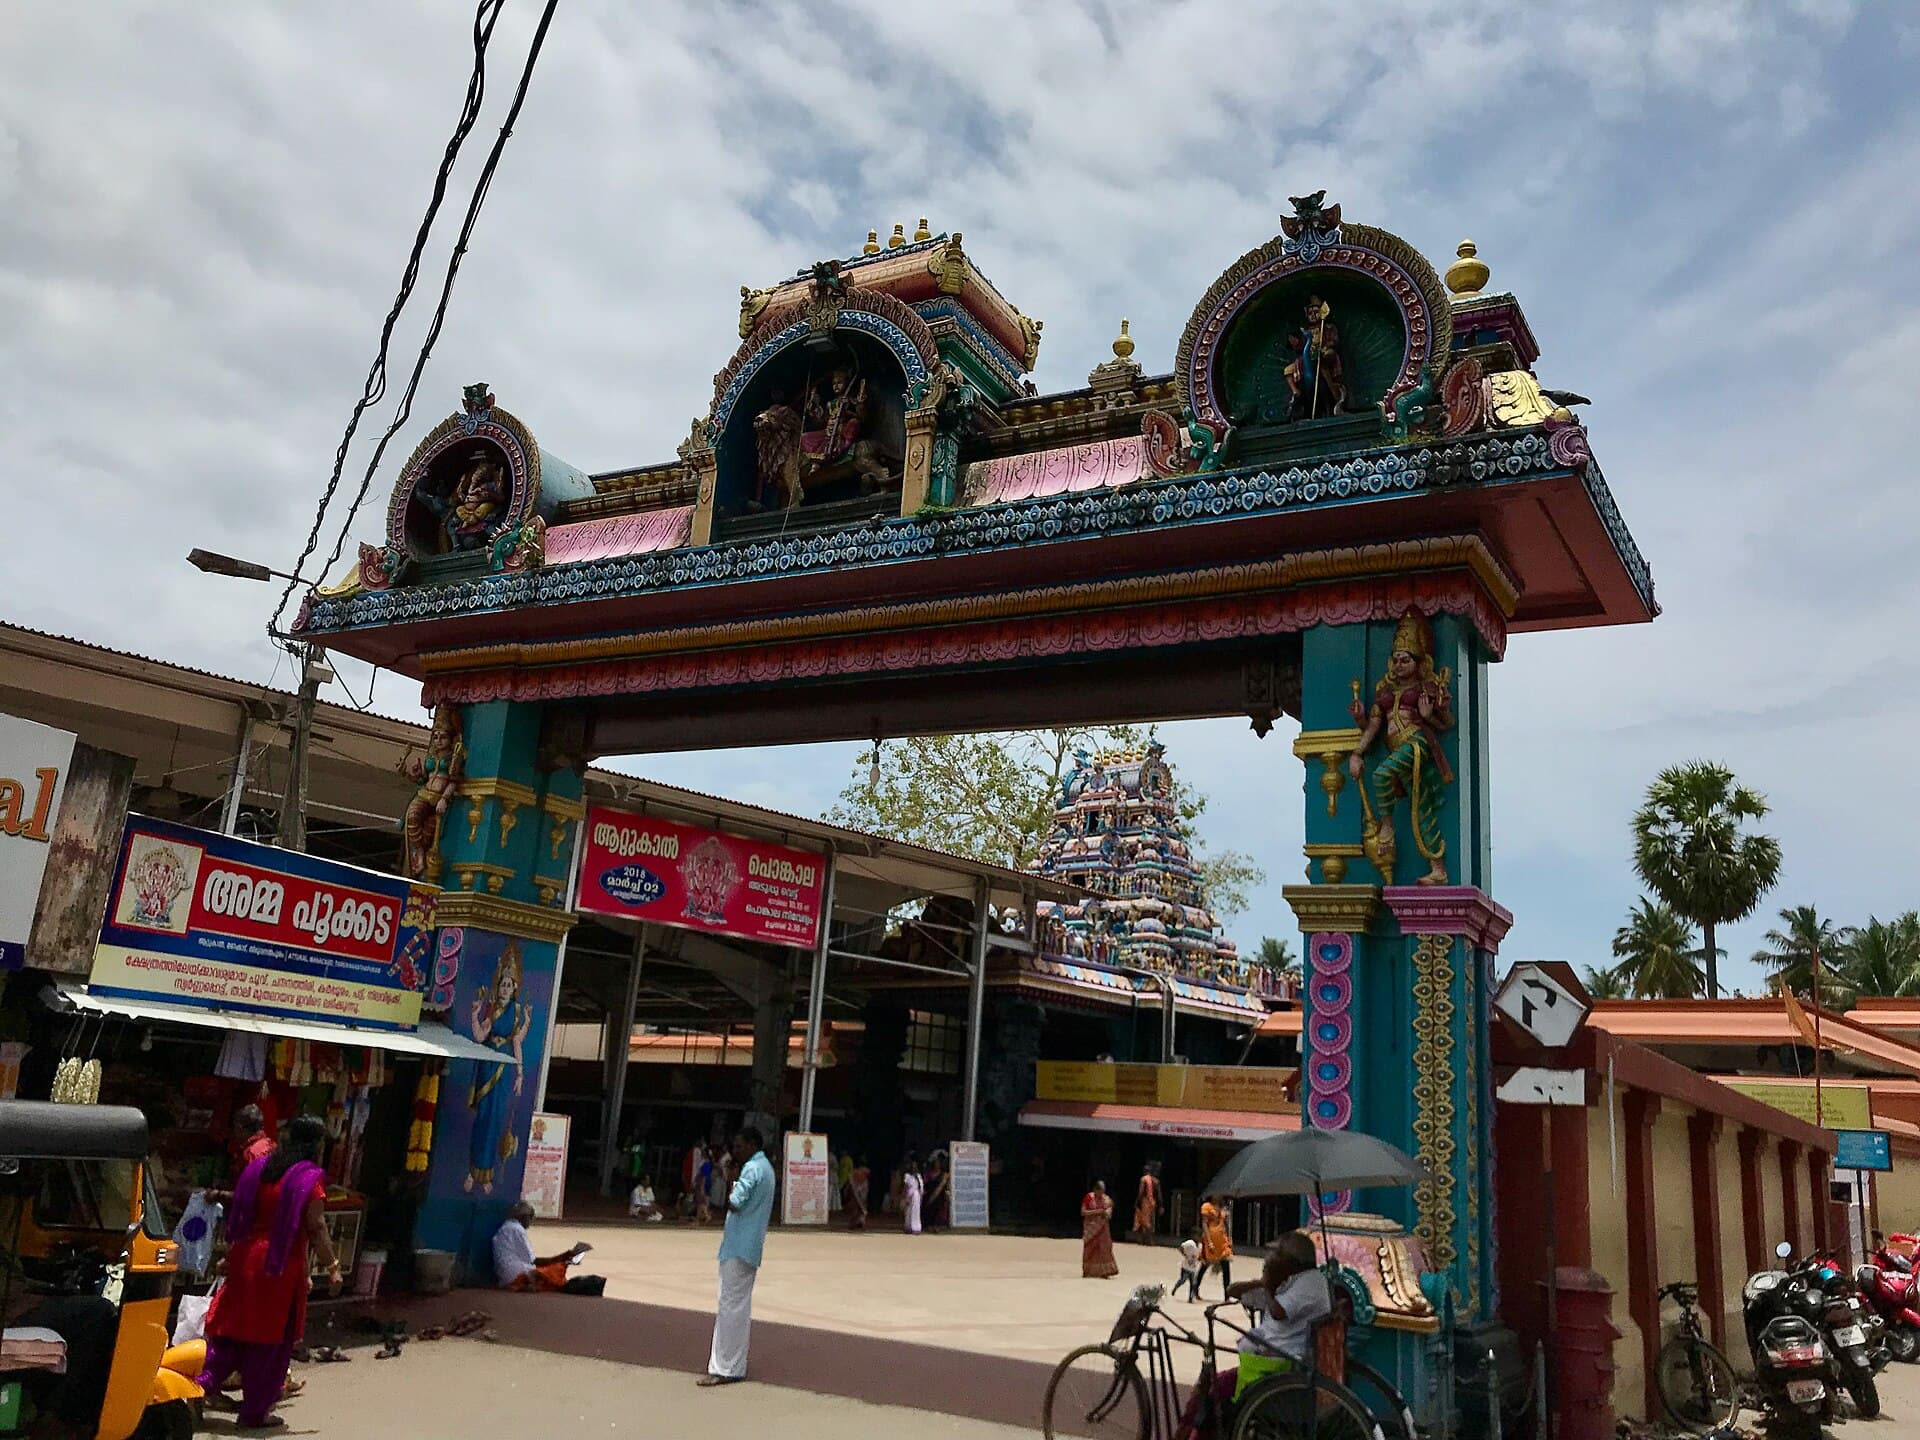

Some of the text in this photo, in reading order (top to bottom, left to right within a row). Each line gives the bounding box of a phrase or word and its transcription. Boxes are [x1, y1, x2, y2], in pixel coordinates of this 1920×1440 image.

[594, 822, 679, 860] ആറ്റുകാൽ
[624, 866, 646, 878] 2018
[643, 882, 659, 893] 02
[749, 854, 815, 888] പൊങ്കാല
[203, 869, 392, 945] അമ്മ പൂക്കട
